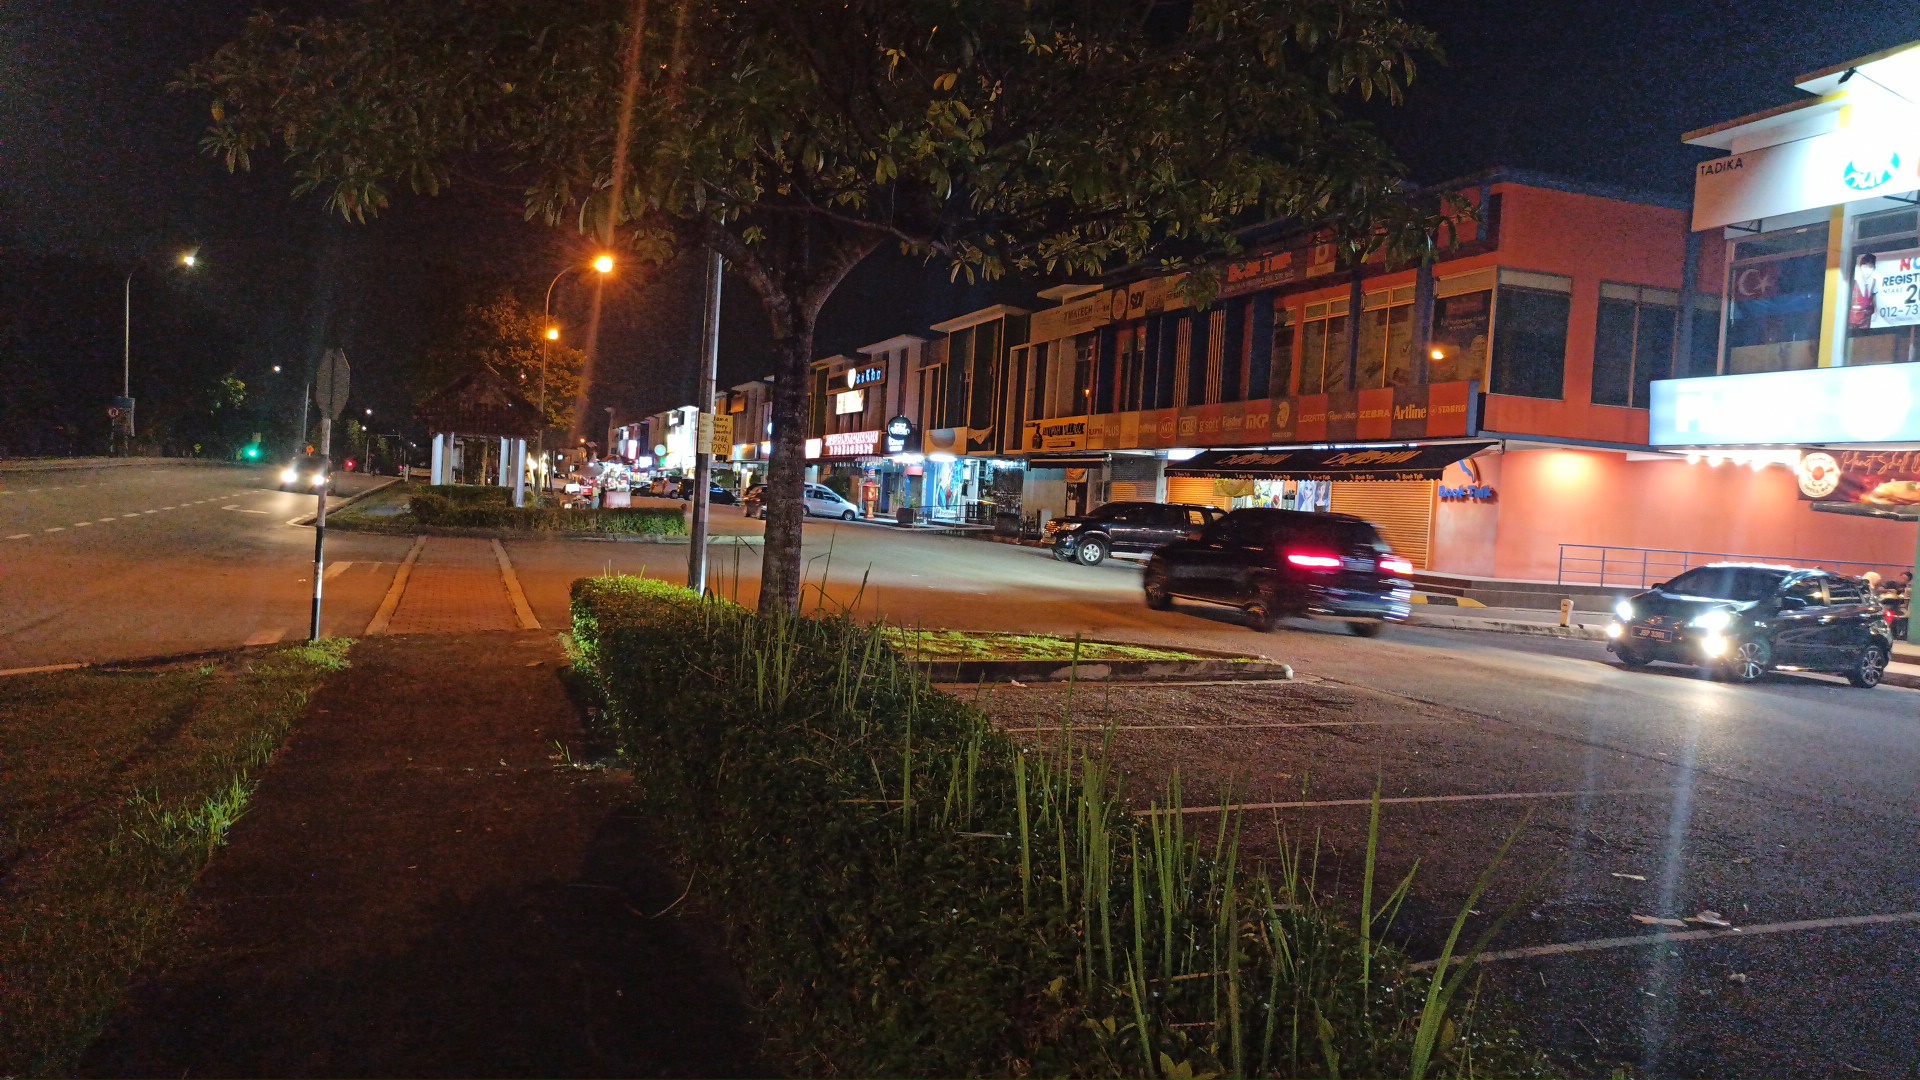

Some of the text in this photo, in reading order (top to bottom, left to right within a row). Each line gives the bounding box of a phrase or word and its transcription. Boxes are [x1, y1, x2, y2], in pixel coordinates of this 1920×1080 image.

[1701, 158, 1743, 176] TADIKA
[1359, 409, 1391, 419] ZEBRA
[1394, 403, 1427, 420] Artline
